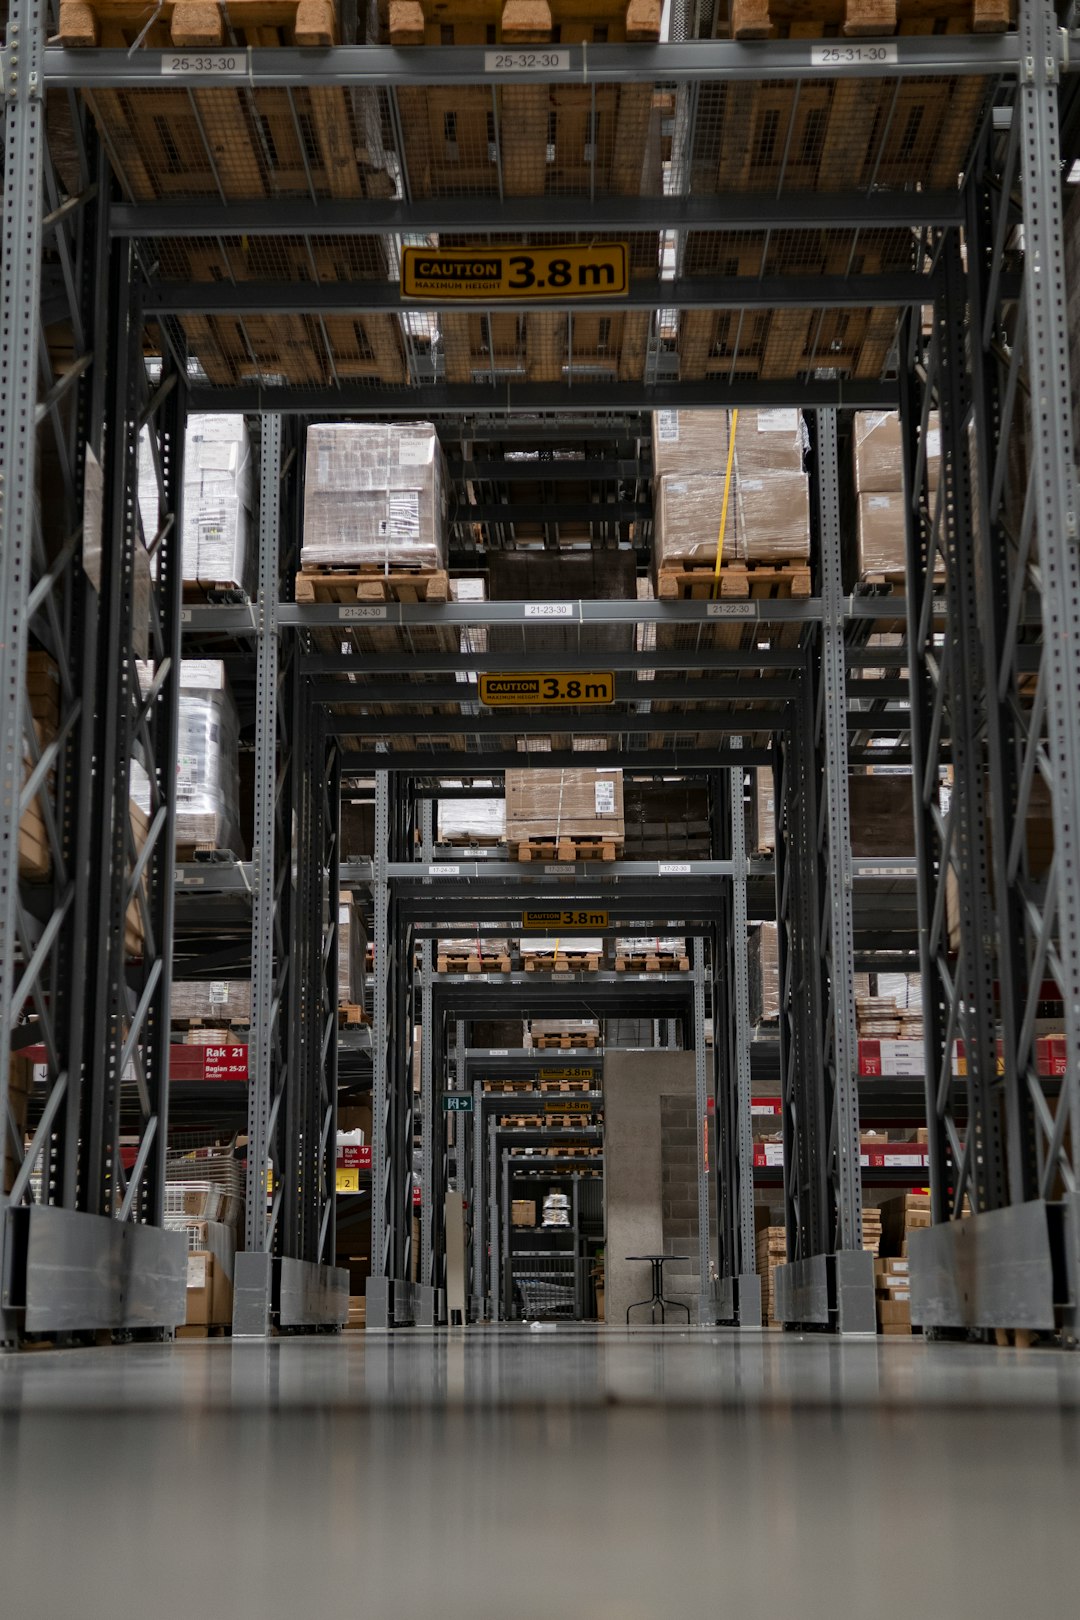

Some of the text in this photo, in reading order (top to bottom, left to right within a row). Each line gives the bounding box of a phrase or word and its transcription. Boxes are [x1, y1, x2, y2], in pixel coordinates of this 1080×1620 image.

[822, 47, 887, 61] 25-31-30
[172, 57, 236, 70] 25-33-30
[495, 54, 559, 68] 25-32-30
[419, 262, 498, 276] CAUTION
[415, 281, 462, 289] MAXIMUM
[344, 607, 381, 617] 21-24-30
[530, 606, 567, 614] 21-23-30
[713, 604, 749, 613] 21-22-30
[489, 682, 537, 691] CAUTION
[206, 1047, 243, 1057] Rak 21
[205, 1065, 228, 1073] Bagian
[865, 1066, 876, 1074] 21
[1055, 1065, 1067, 1074] 20
[344, 1180, 350, 1188] 2
